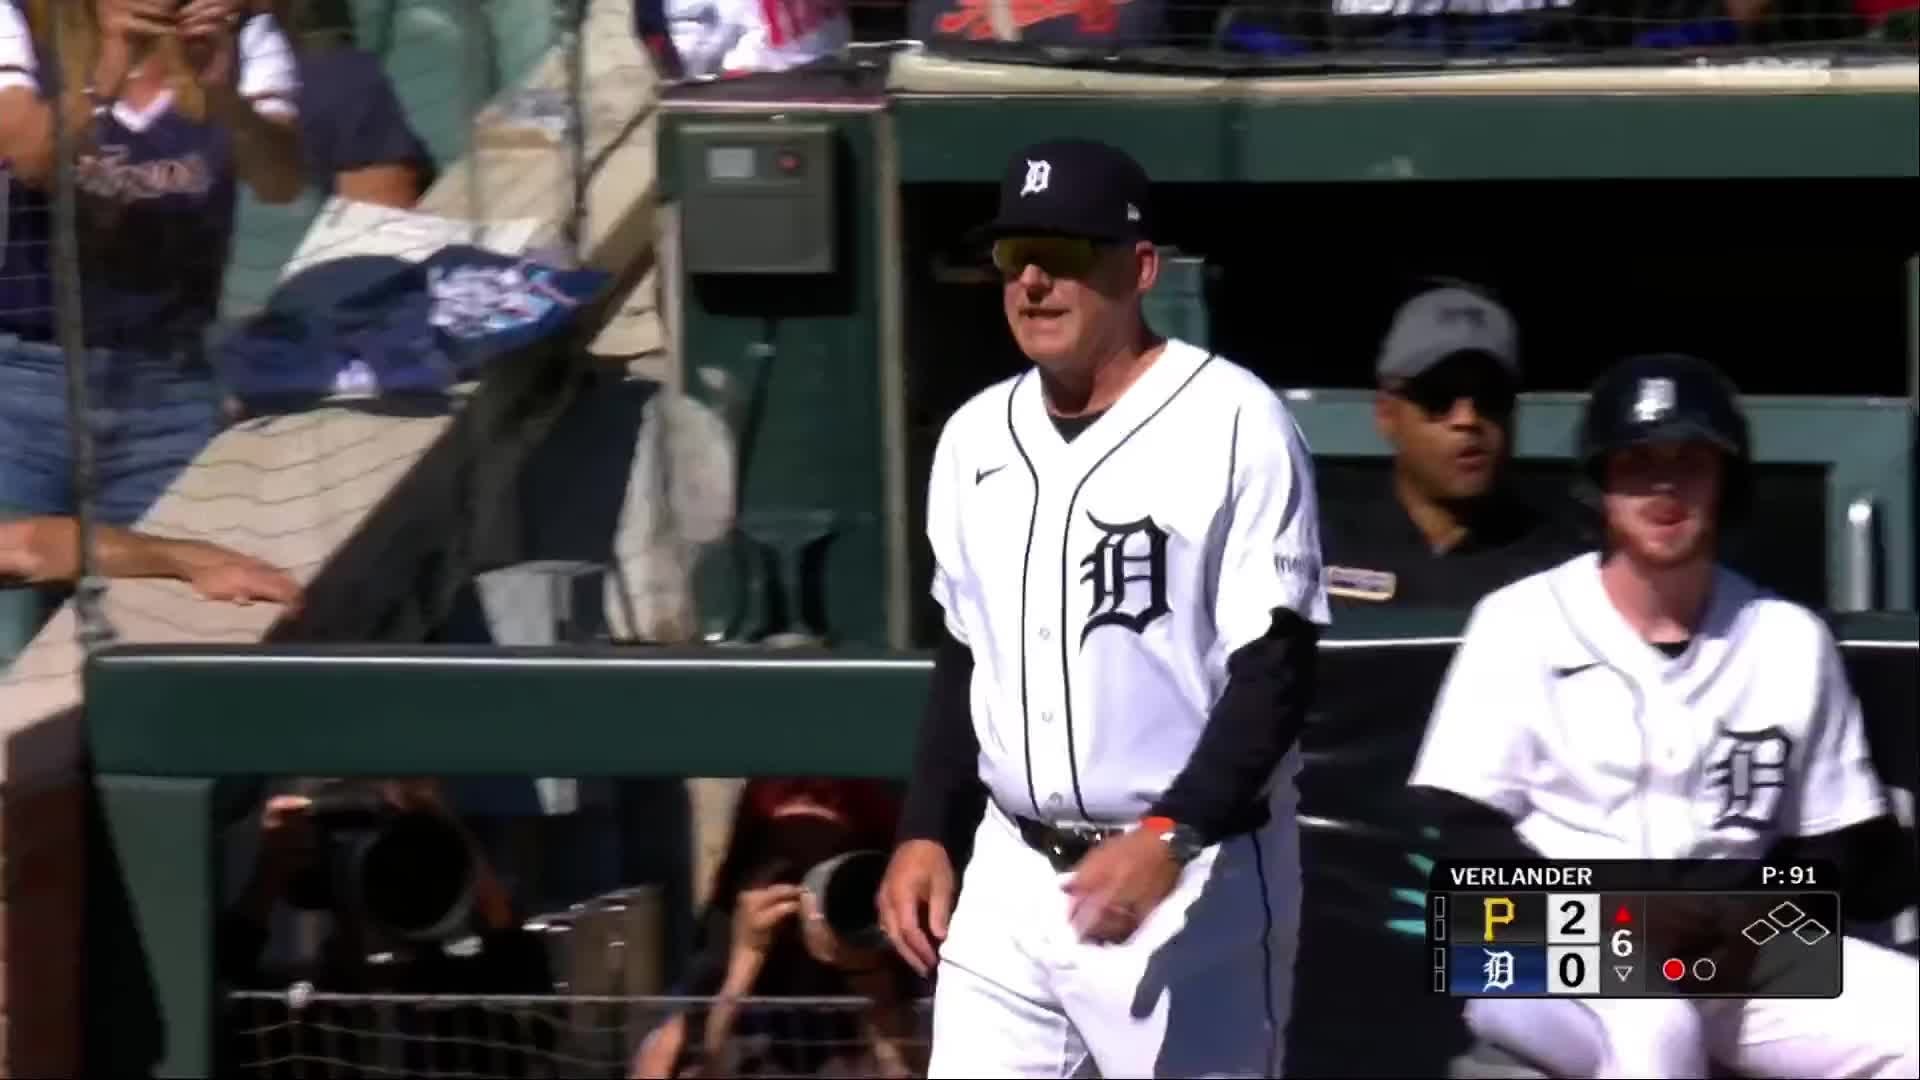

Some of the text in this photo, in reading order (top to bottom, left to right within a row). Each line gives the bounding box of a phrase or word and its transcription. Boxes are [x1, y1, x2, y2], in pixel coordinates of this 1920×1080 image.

[1020, 159, 1052, 198] D
[1079, 510, 1174, 655] D
[1703, 722, 1793, 832] D
